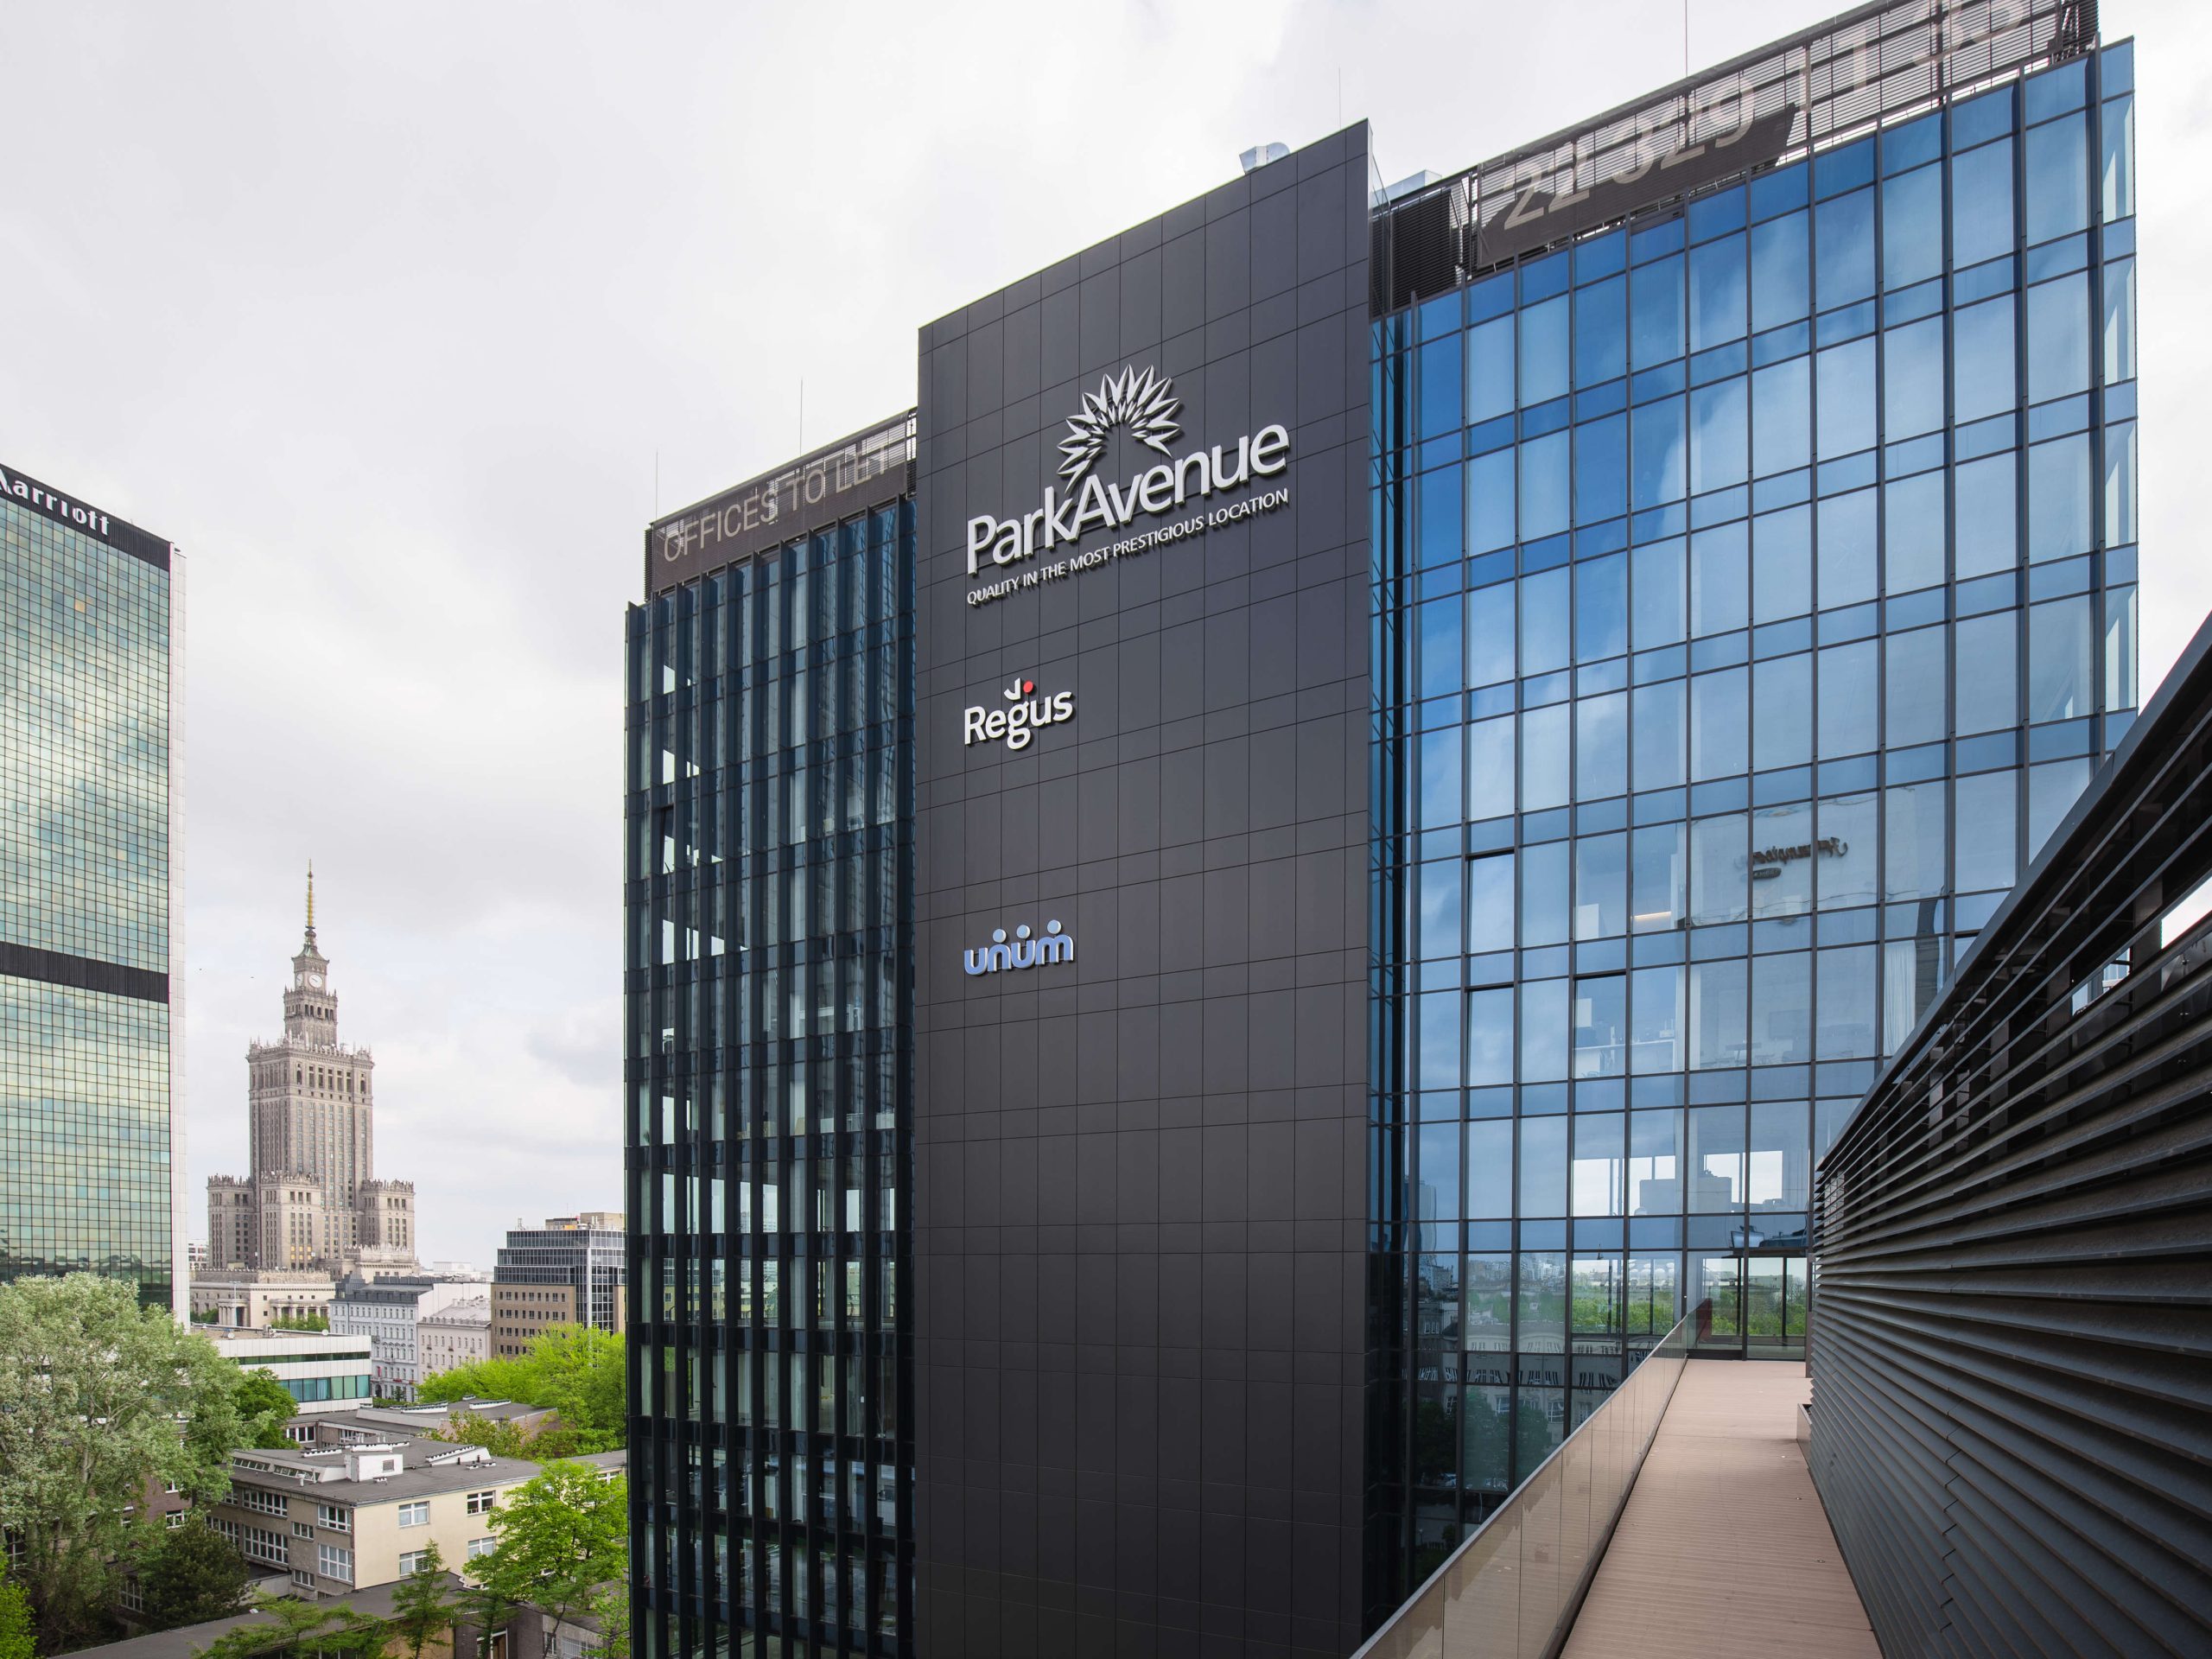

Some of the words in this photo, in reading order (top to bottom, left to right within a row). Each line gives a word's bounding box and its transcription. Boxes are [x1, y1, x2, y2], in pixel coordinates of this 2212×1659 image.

[664, 486, 777, 563] OFFICES
[785, 469, 826, 512] TO
[836, 442, 889, 493] LET
[967, 576, 1020, 605] QUALITY
[1023, 571, 1039, 588] IN
[1040, 562, 1067, 582] THE
[1070, 546, 1111, 572] MOST
[1113, 516, 1205, 557] PRESTIGIOUS
[1208, 487, 1289, 526] LOCATION
[964, 690, 1074, 750] Regus
[963, 919, 1074, 976] unum
